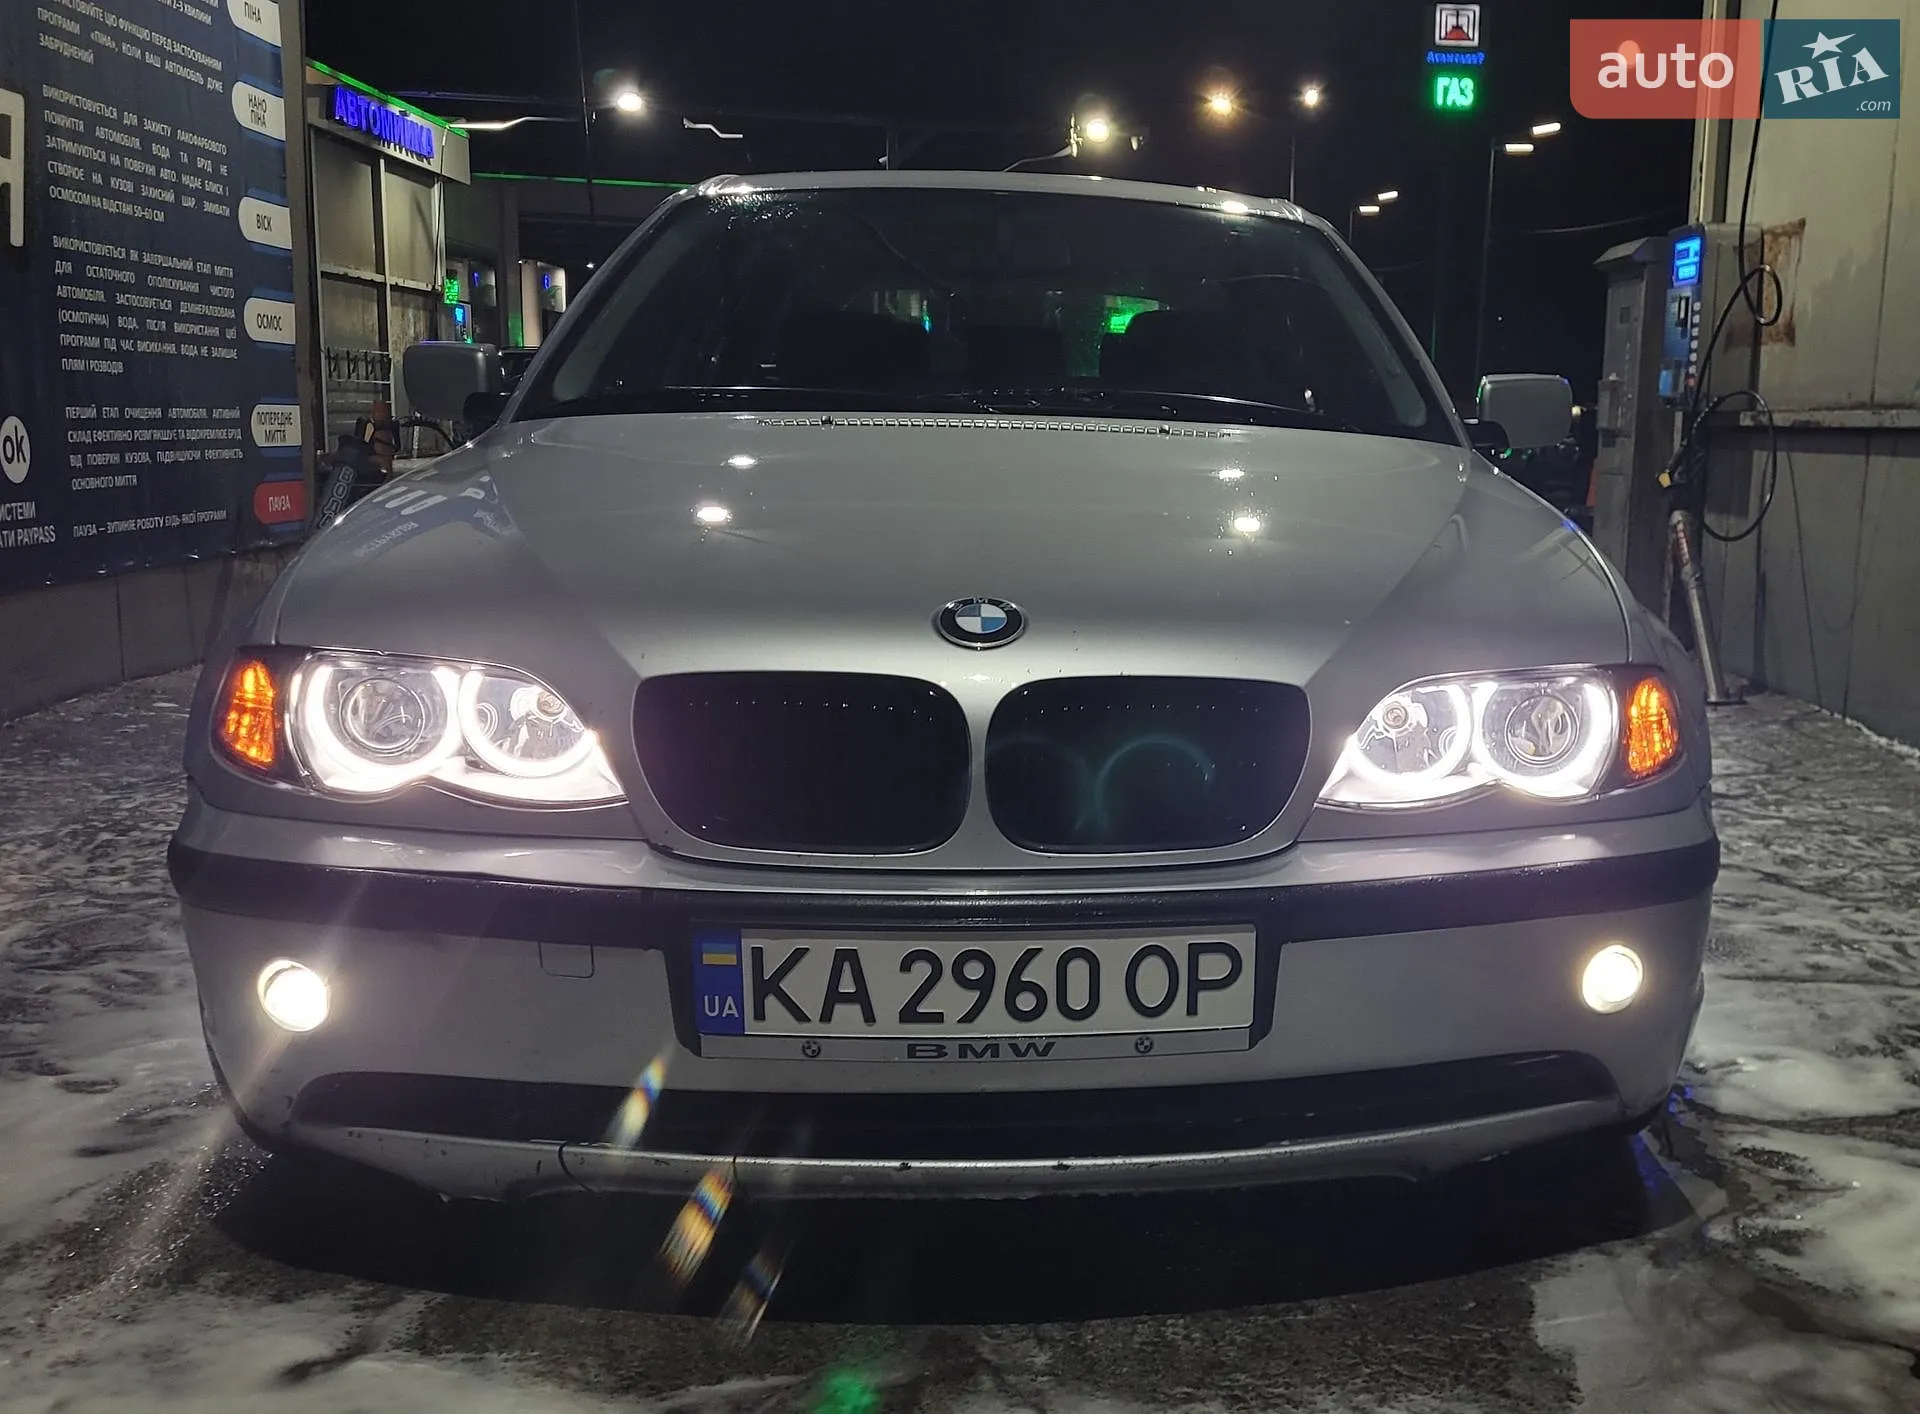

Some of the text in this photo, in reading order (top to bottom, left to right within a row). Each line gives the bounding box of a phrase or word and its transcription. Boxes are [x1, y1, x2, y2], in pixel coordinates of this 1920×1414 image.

[244, 3, 262, 24] ПІНА
[37, 7, 81, 35] ПРОГРАМИ
[121, 41, 142, 60] КОЛИ
[145, 51, 161, 68] ВАШ
[164, 59, 204, 85] АВТОМОБІЛЬ
[206, 76, 224, 93] ДУЖЕ
[151, 31, 172, 53] ПЕРЕД
[172, 40, 222, 71] ЗАСТОСУВАННЯМ
[1436, 76, 1474, 106] ГАЗ
[248, 93, 267, 114] НАНО
[42, 84, 228, 156] ВИКОРИСТОВУЄТЬСЯ ДЛЯ ЗАХИСТУ ЛАКОФАРБОВОГО
[250, 109, 266, 128] ПІНА
[44, 110, 84, 132] ПОКРИТТЯ
[152, 143, 171, 160] ВОДА
[180, 151, 189, 164] ТА
[196, 157, 213, 174] БРУД
[220, 164, 228, 176] НЕ
[45, 135, 107, 163] ЗАТРИМУЮТЬСЯ
[110, 153, 121, 168] НА
[124, 157, 156, 176] ПОВЕРХНІ
[181, 173, 202, 189] НАДАЄ
[205, 180, 224, 195] БЛИСК
[47, 160, 85, 181] СТВОРЮЄ
[92, 171, 104, 186] НА
[110, 176, 134, 193] КУЗОВІ
[140, 184, 175, 203] ЗАХИСНИЙ
[203, 200, 231, 217] ЗМИВАТИ
[49, 185, 90, 206] ОСМОСОМ
[90, 194, 102, 209] НА
[102, 197, 133, 215] ВІДСТАНІ
[153, 209, 165, 222] СМ
[256, 213, 272, 232] ВІСК
[52, 235, 234, 279] ВИКОРИСТОВУЄТЬСЯ ЯК ЗАВЕРШАЛЬНИЙ ЕТАП МИТТЯ
[54, 260, 235, 299] ДЛЯ ОСТАТОЧНОГО ОПОЛІСКУВАННЯ ЧИСТОГО
[115, 292, 173, 312] ЗАСТОСОВУЄТЬСЯ
[58, 308, 110, 329] (ОСМОТИЧНА)
[146, 319, 167, 332] ПІСЛЯ
[174, 321, 220, 338] ВИКОРИСТАННЯ
[256, 313, 283, 332] ОСМОС
[60, 333, 101, 349] ПРОГРАМИ
[103, 337, 118, 352] ПІД
[120, 339, 135, 351] ЧАС
[181, 343, 199, 358] ВОДА
[201, 345, 209, 357] НЕ
[61, 358, 85, 372] ПЛЯМ
[90, 360, 124, 376] РОЗВОДІВ
[65, 403, 97, 419] ПЕРШИЙ
[102, 406, 119, 419] ЕТАП
[124, 406, 162, 420] ОЧИЩЕННЯ
[212, 406, 241, 419] АКТИВНИЙ
[2, 425, 26, 465] ok
[67, 429, 92, 444] СКЛАД
[93, 429, 132, 442] ЕФЕКТИВНО
[178, 430, 186, 440] ТА
[228, 428, 243, 441] БРУД
[265, 429, 287, 444] МИТТЯ
[69, 454, 82, 468] ВІД
[87, 453, 120, 466] ПОВЕРХНІ
[204, 448, 243, 460] ЕФЕКТИВНІСТЬ
[71, 474, 138, 491] ОСНОВНОГО МИТТЯ
[268, 495, 291, 512] ПАУЗА
[73, 524, 97, 537] ПАУЗА
[107, 519, 136, 534] ЗУПИНЯЄ
[137, 516, 164, 530] РОБОТУ
[197, 510, 227, 522] ПРОГРАМИ
[17, 525, 56, 546] PAYPASS
[749, 941, 1243, 1024] KA 2960 OP
[704, 995, 739, 1018] UA
[906, 1041, 1056, 1059] BMW
